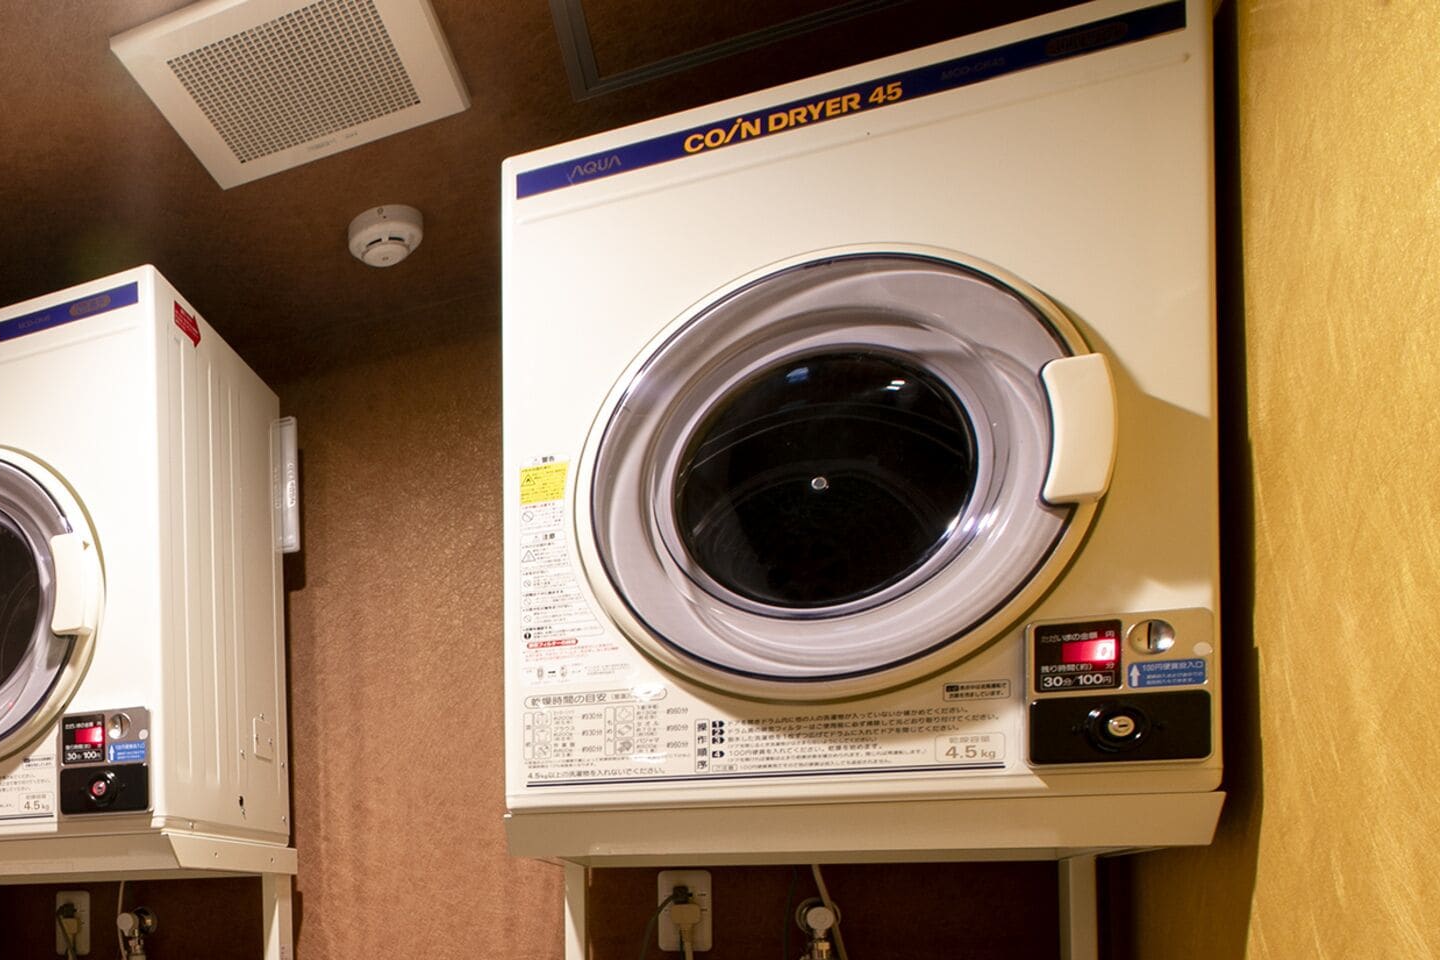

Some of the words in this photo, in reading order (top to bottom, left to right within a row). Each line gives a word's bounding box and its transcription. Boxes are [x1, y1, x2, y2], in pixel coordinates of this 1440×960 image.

[768, 92, 862, 132] DRYER
[868, 81, 903, 105] 45
[945, 745, 977, 759] 4.5
[981, 749, 996, 760] kg
[24, 800, 41, 811] 4.5
